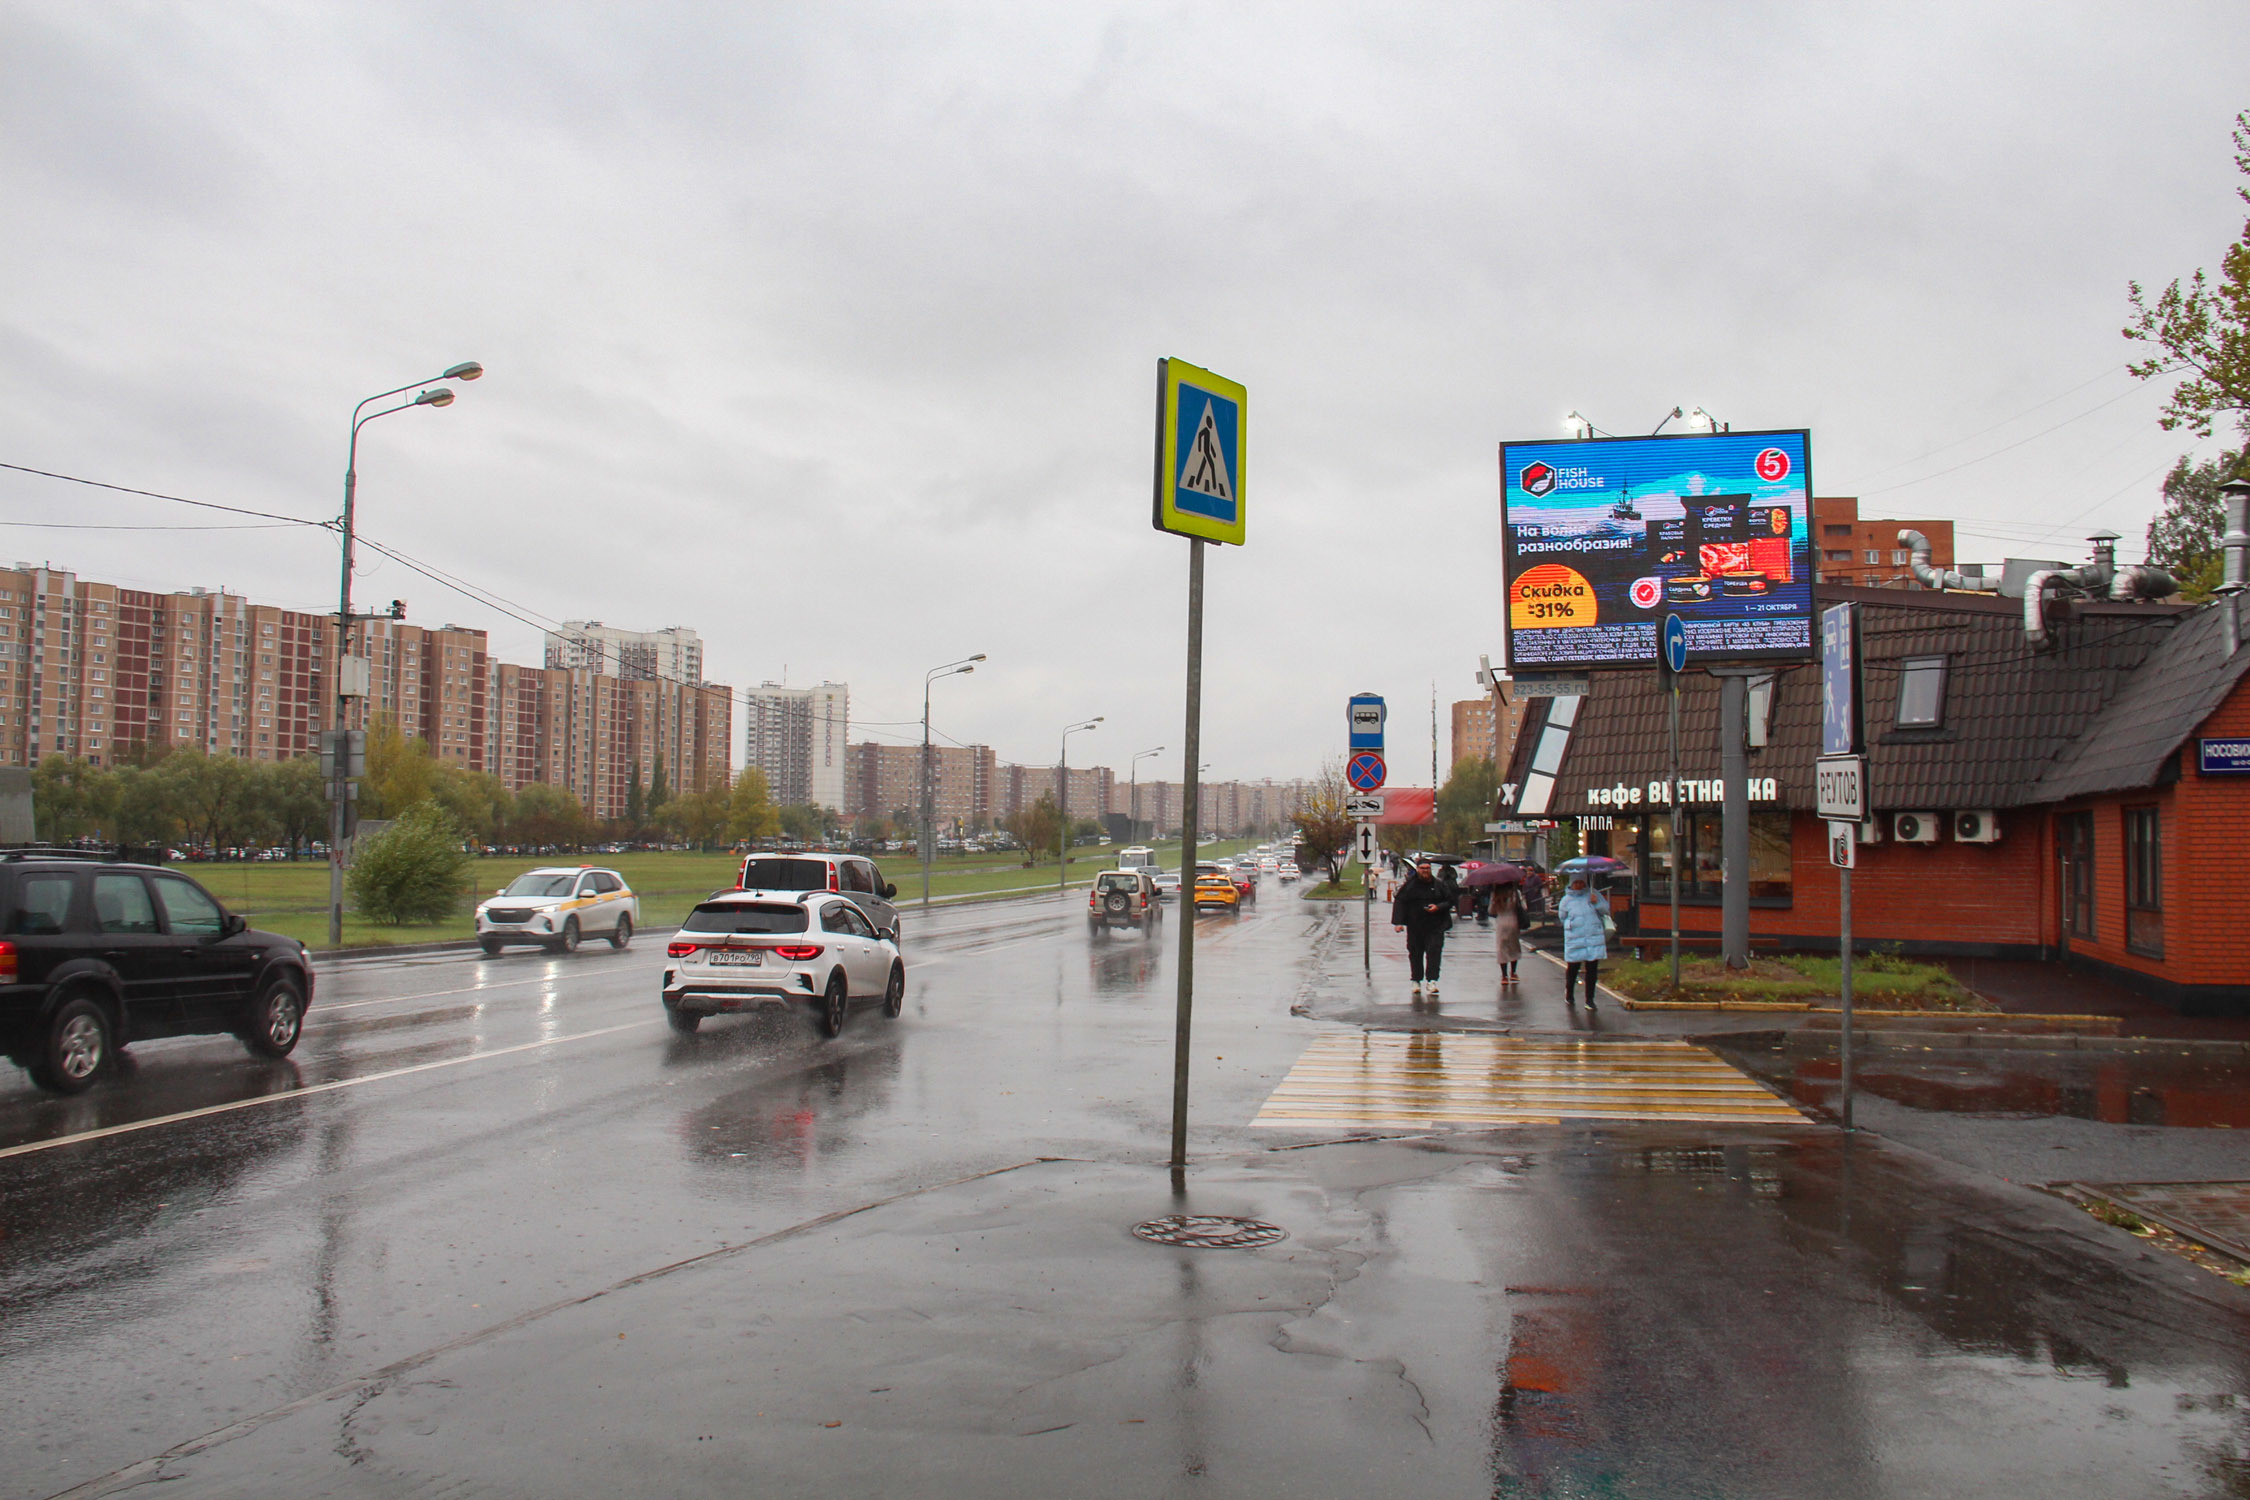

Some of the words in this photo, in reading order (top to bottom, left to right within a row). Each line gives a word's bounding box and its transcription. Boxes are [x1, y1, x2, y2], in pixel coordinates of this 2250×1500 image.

[1558, 467, 1588, 478] FISH
[1558, 477, 1605, 489] HOUSE
[1517, 525, 1538, 537] На
[1518, 537, 1632, 556] разнообразия!
[1520, 583, 1584, 597] Скидка
[1765, 603, 1797, 611] ОКТЯБРЯ
[1587, 783, 1642, 809] кафе
[1648, 777, 1777, 804] ВЬЕТНАКА
[1820, 770, 1858, 806] РЕУТОВ
